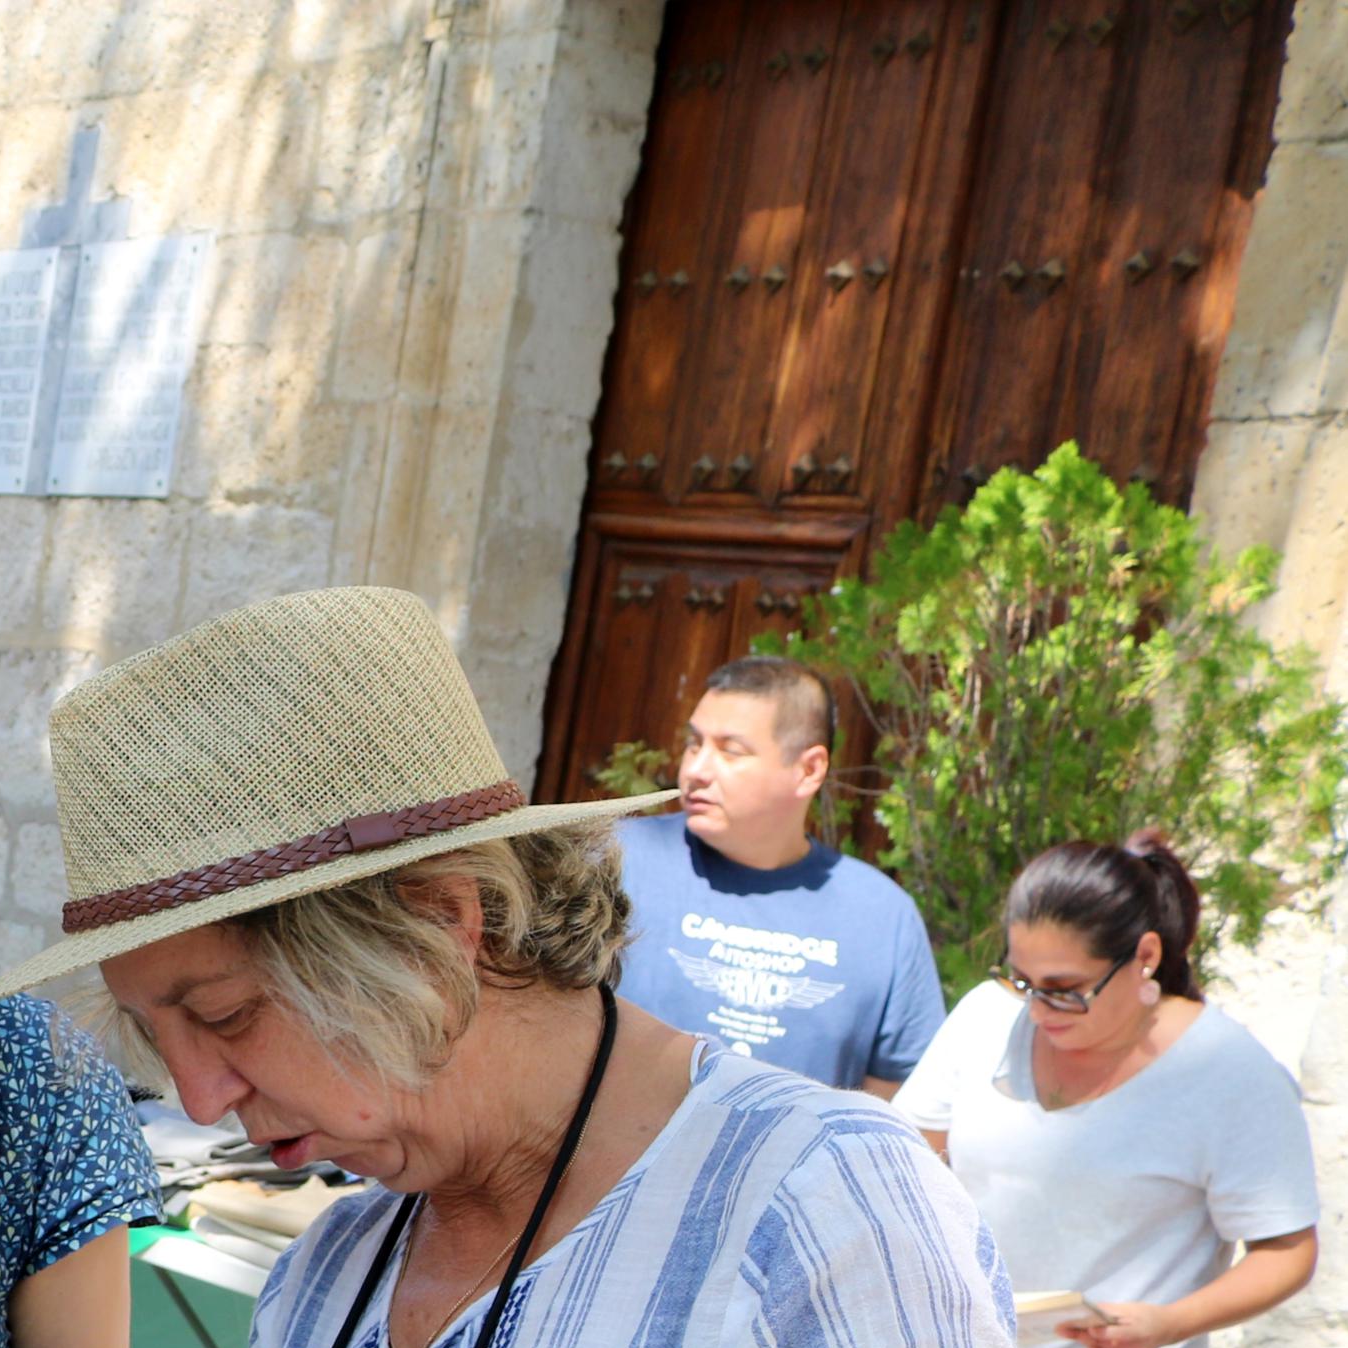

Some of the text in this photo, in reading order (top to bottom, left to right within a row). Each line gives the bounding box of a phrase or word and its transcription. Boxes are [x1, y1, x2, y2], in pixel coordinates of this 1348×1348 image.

[681, 913, 838, 967] CAMBRIDGE
[708, 941, 806, 974] AUTOSHOP
[715, 967, 794, 1008] SERVICE
